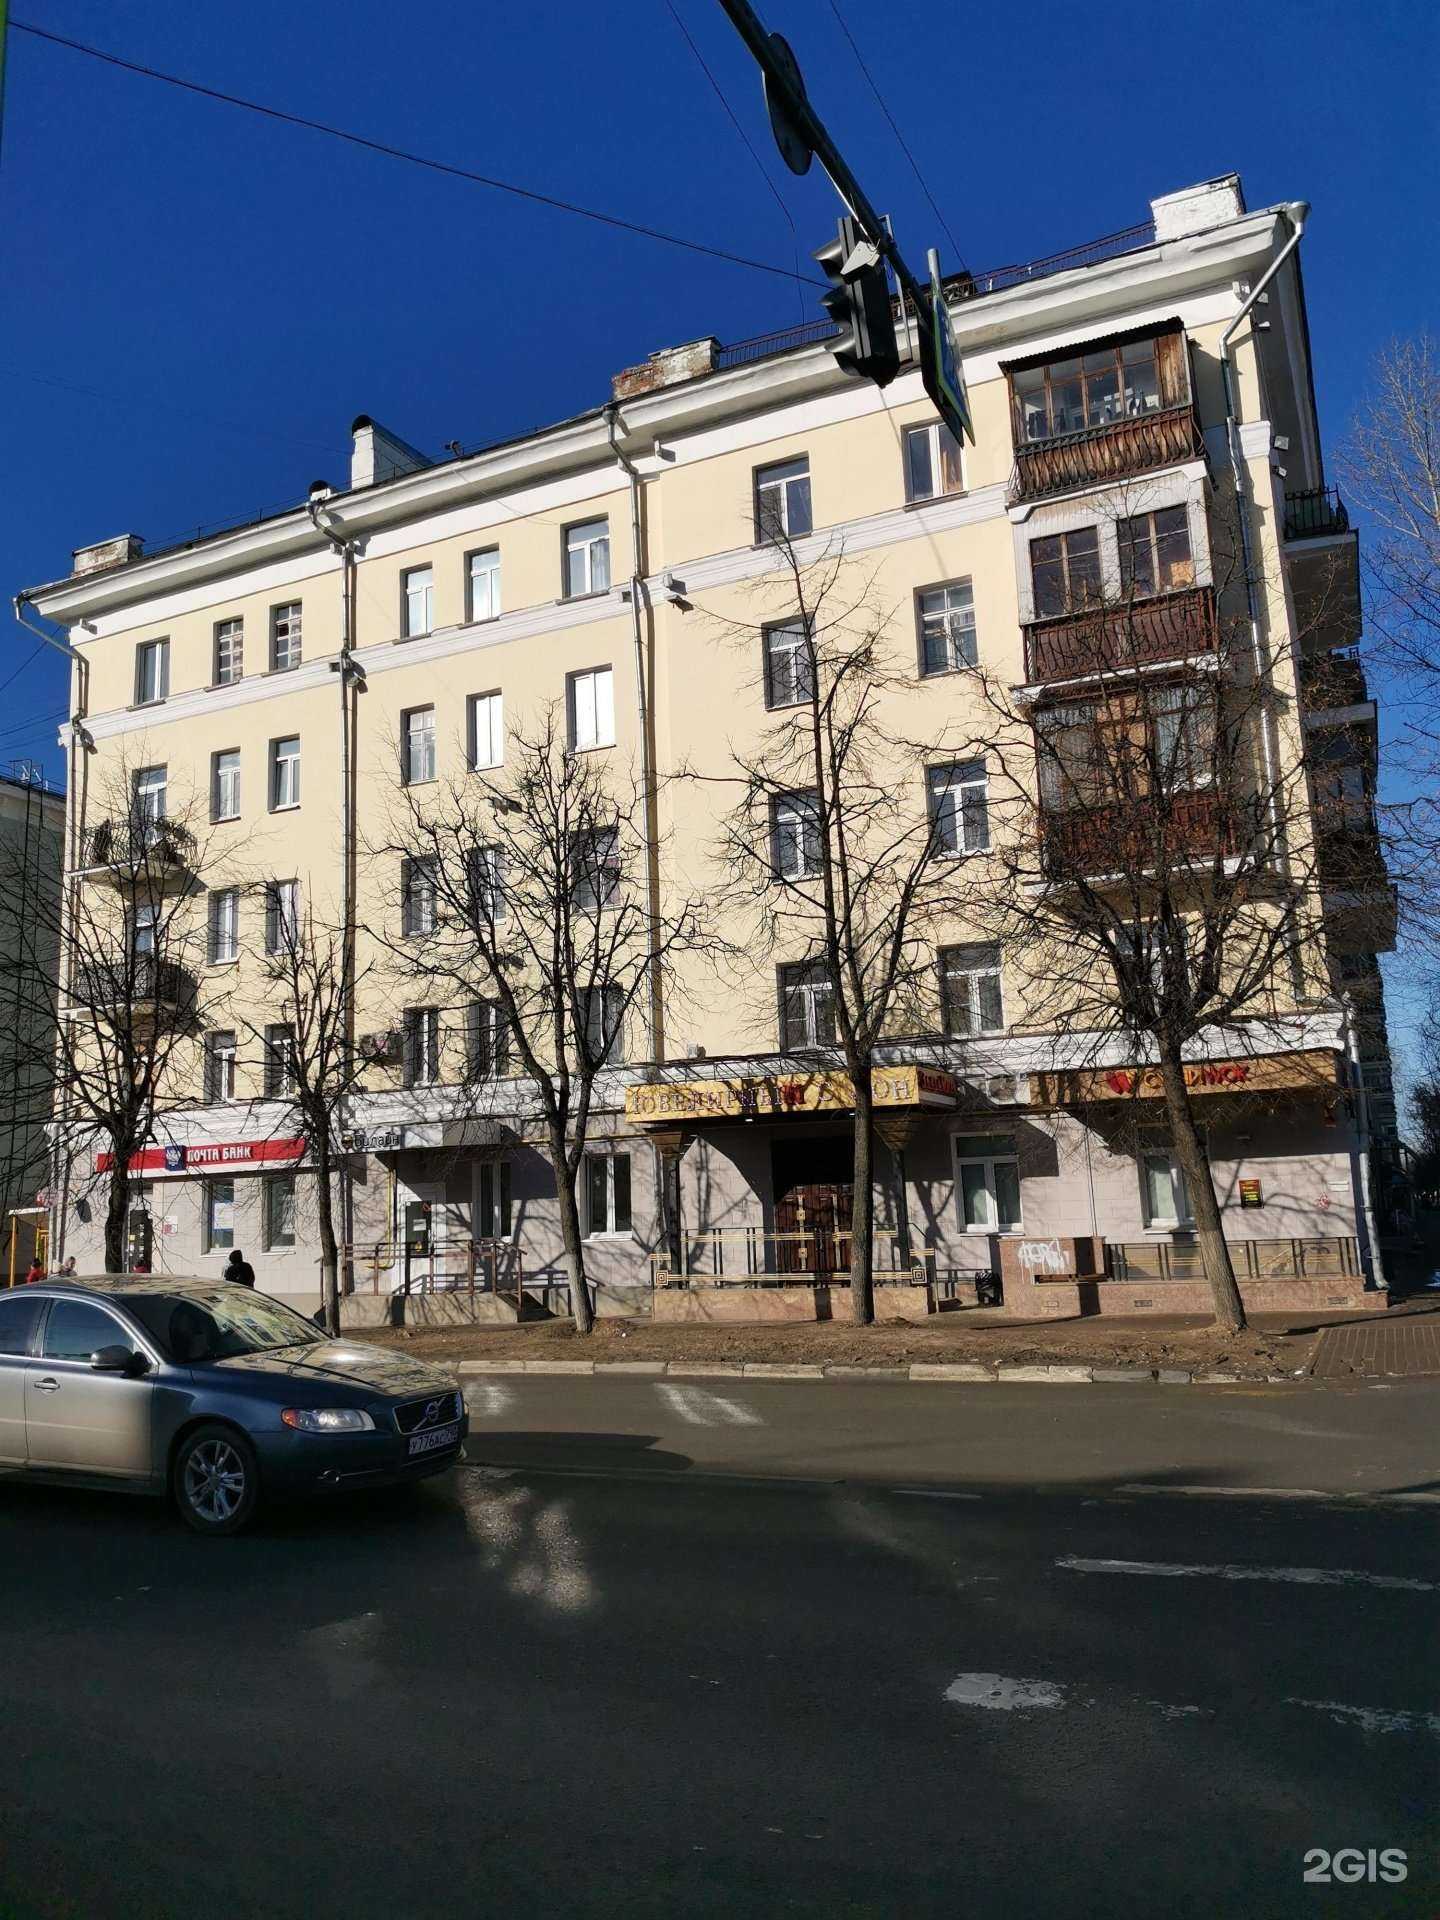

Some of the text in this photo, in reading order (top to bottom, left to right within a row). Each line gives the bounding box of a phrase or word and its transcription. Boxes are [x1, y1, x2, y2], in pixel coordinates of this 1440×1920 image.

[818, 1078, 913, 1101] СОН
[187, 1146, 252, 1162] ПОЧТА БАНК
